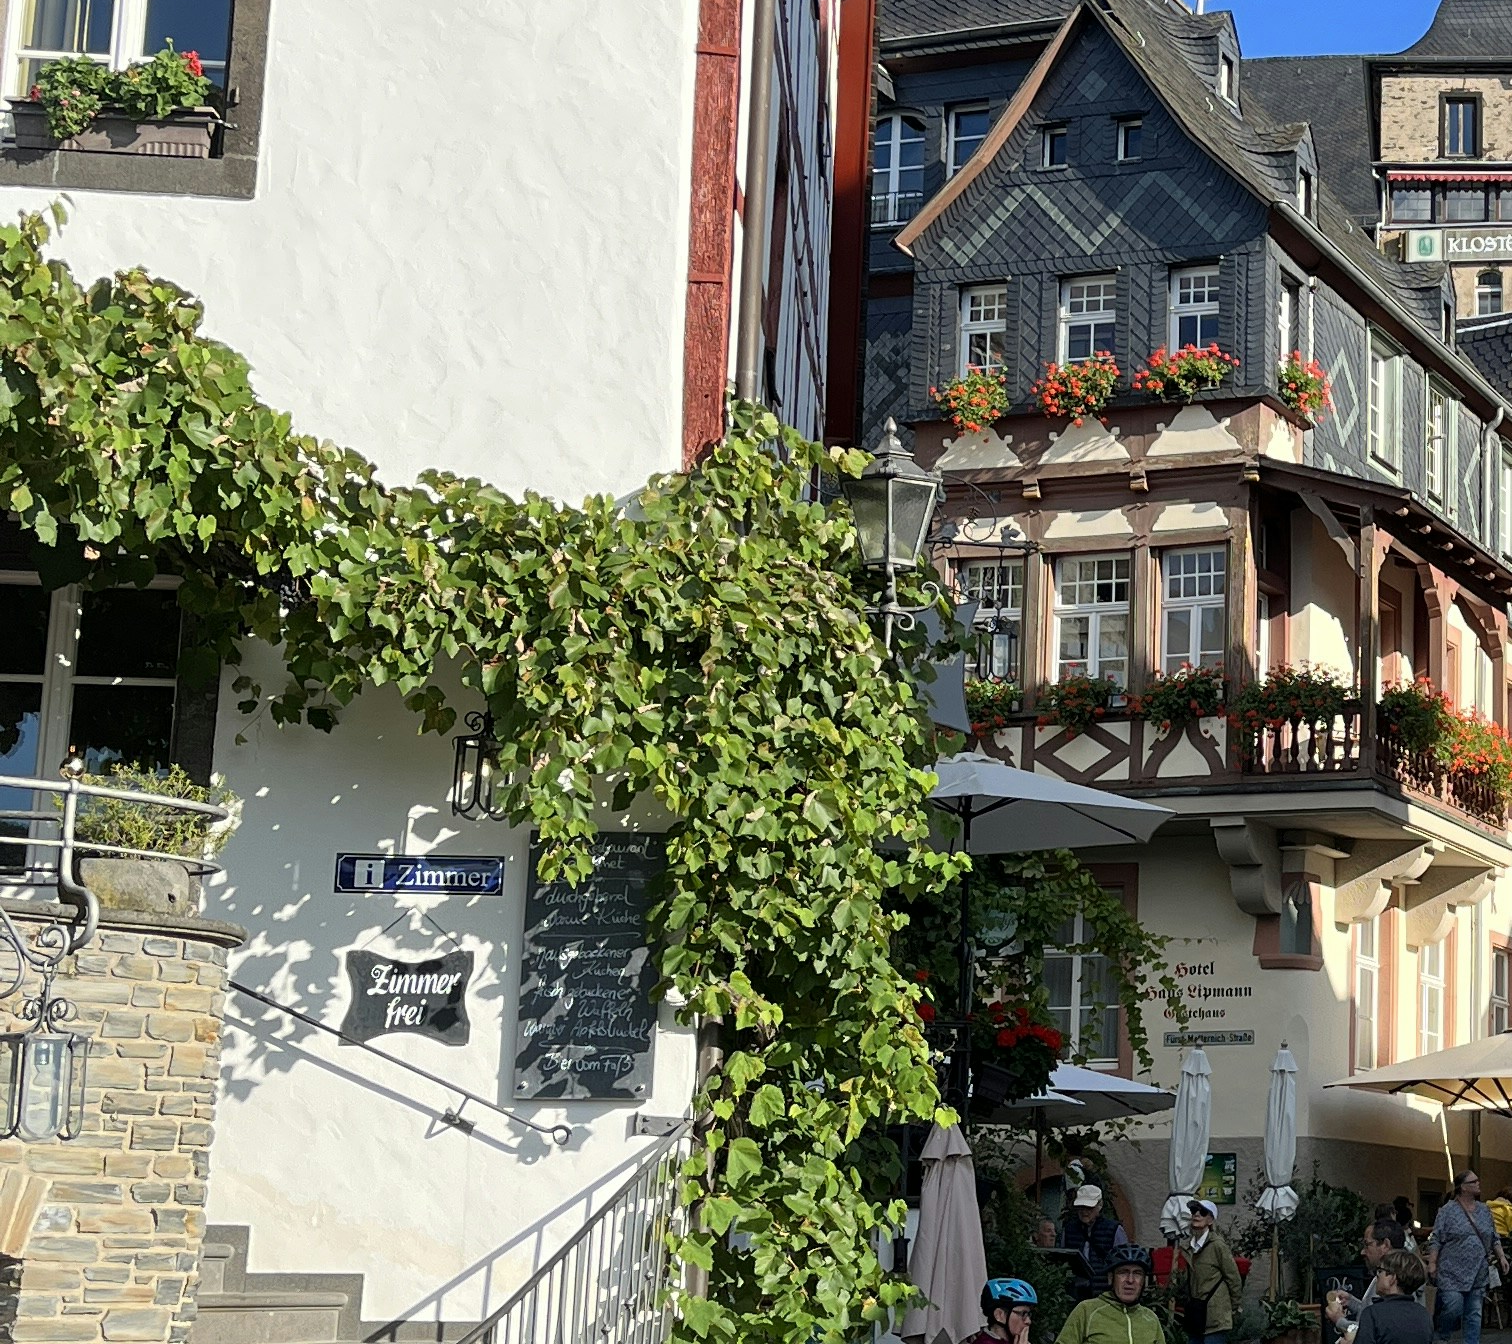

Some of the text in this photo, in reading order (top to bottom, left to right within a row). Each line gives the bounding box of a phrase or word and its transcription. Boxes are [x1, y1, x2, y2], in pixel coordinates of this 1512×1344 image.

[396, 864, 492, 887] Zimmer
[367, 964, 461, 995] Zimmer
[1174, 961, 1215, 978] Hotel
[1145, 984, 1252, 1002] Haus Lipmann
[385, 997, 427, 1029] frei
[1163, 1007, 1226, 1020] Gstehaus
